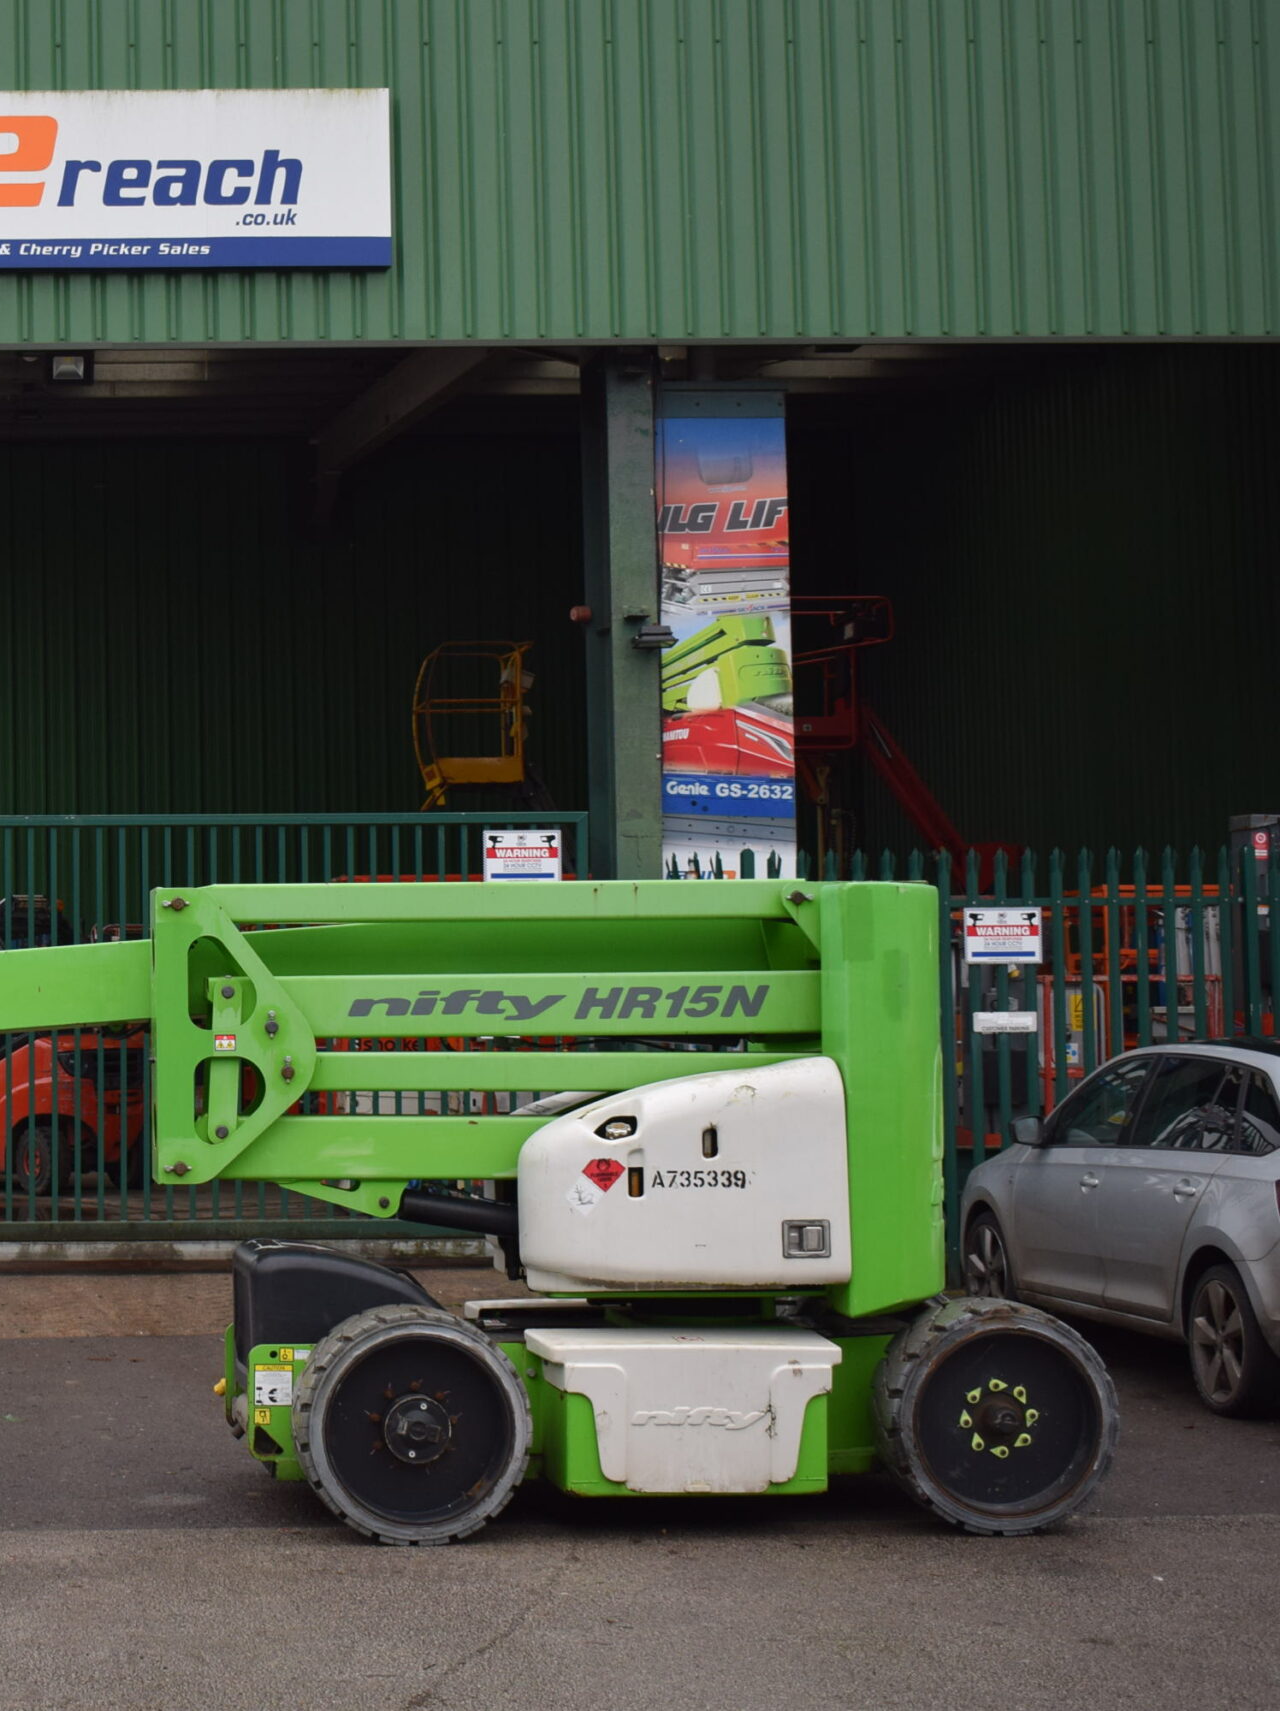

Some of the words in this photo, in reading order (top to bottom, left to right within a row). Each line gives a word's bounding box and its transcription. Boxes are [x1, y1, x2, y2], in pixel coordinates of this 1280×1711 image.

[235, 209, 298, 226] .co.uk
[0, 243, 11, 255] &
[19, 243, 81, 257] Cherry
[89, 243, 151, 255] Picker
[158, 243, 211, 255] Sales
[666, 781, 710, 796] Genie
[715, 783, 793, 799] GS-2632
[495, 848, 550, 858] WARNING
[976, 926, 1031, 936] WARNING
[348, 989, 567, 1021] nifty
[574, 984, 770, 1021] HR15N
[652, 1170, 746, 1188] A735339
[631, 1406, 770, 1430] nifty
